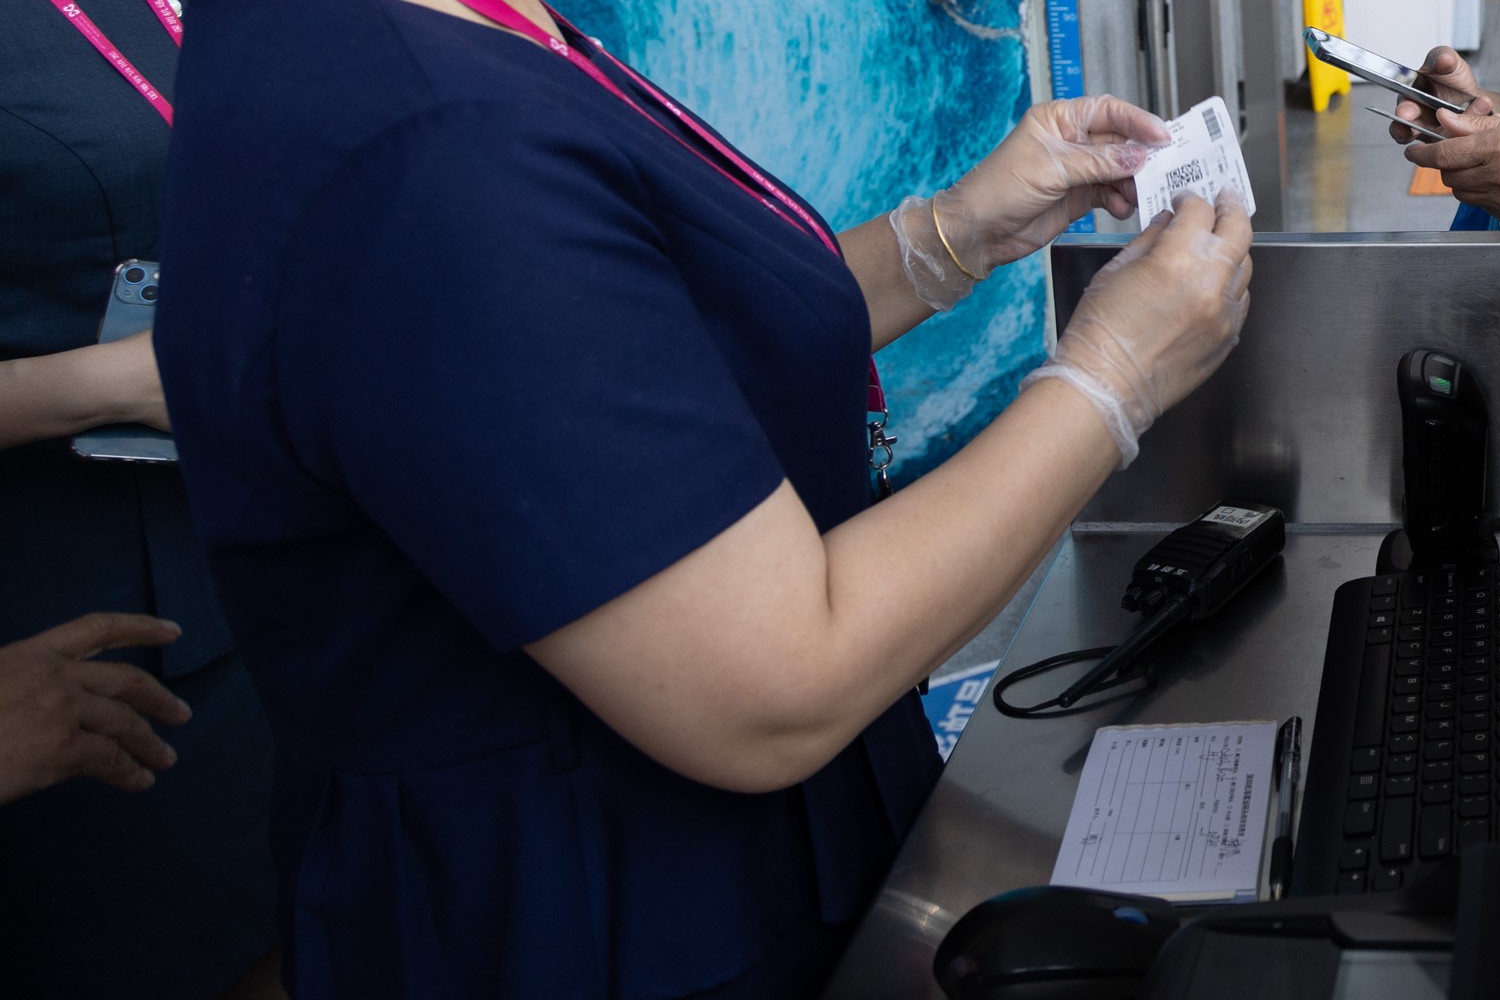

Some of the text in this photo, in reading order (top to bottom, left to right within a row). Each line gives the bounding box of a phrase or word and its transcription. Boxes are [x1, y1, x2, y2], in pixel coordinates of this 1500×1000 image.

[108, 50, 158, 100] 深圳机场集团
